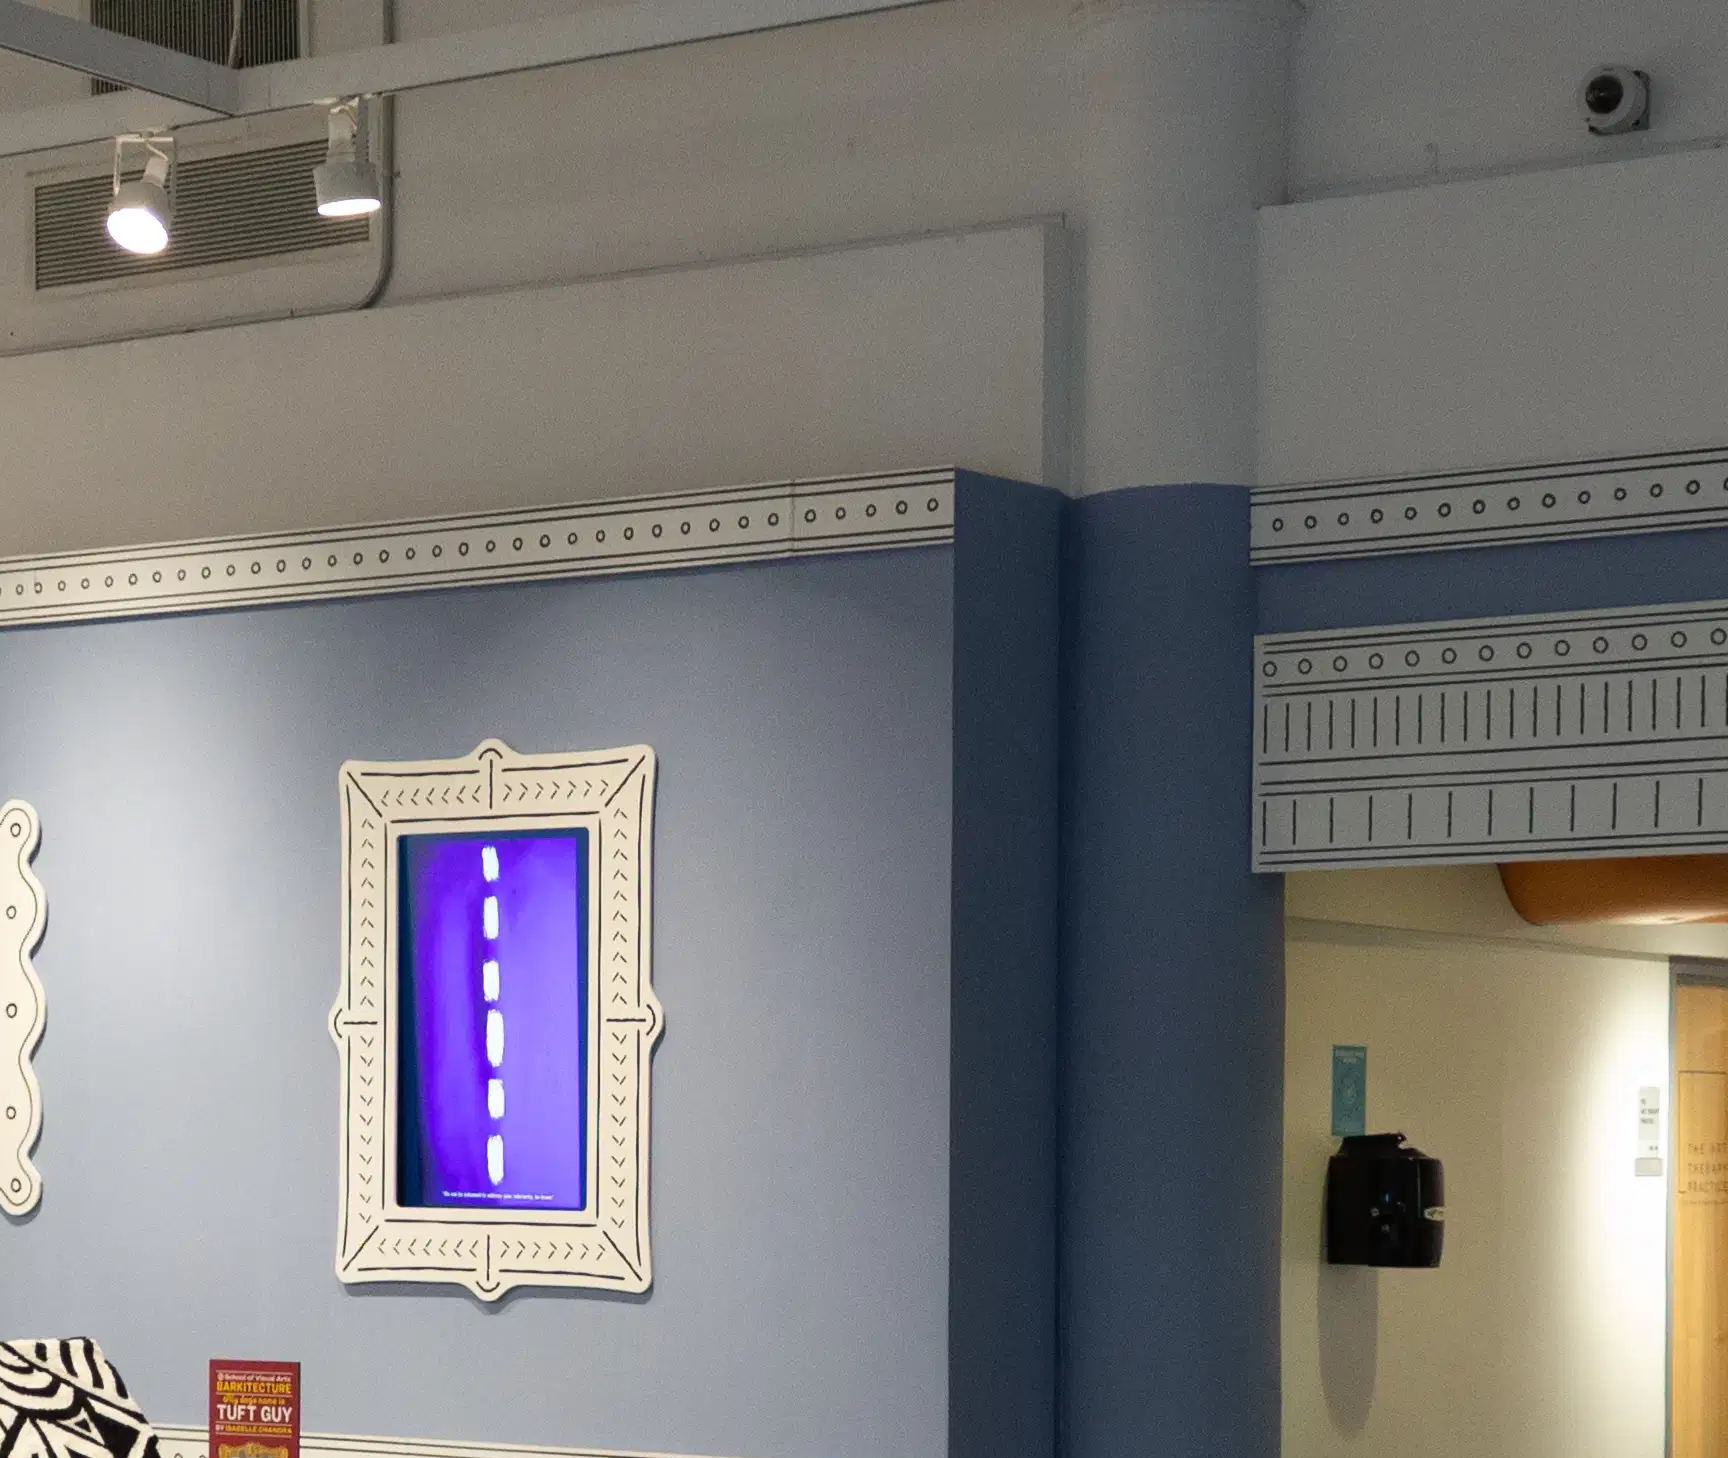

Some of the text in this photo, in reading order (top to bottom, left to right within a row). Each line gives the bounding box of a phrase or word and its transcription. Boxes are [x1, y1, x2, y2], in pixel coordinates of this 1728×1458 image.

[216, 1381, 292, 1394] BARKITECTURE
[216, 1404, 293, 1424] TUFT GUY
